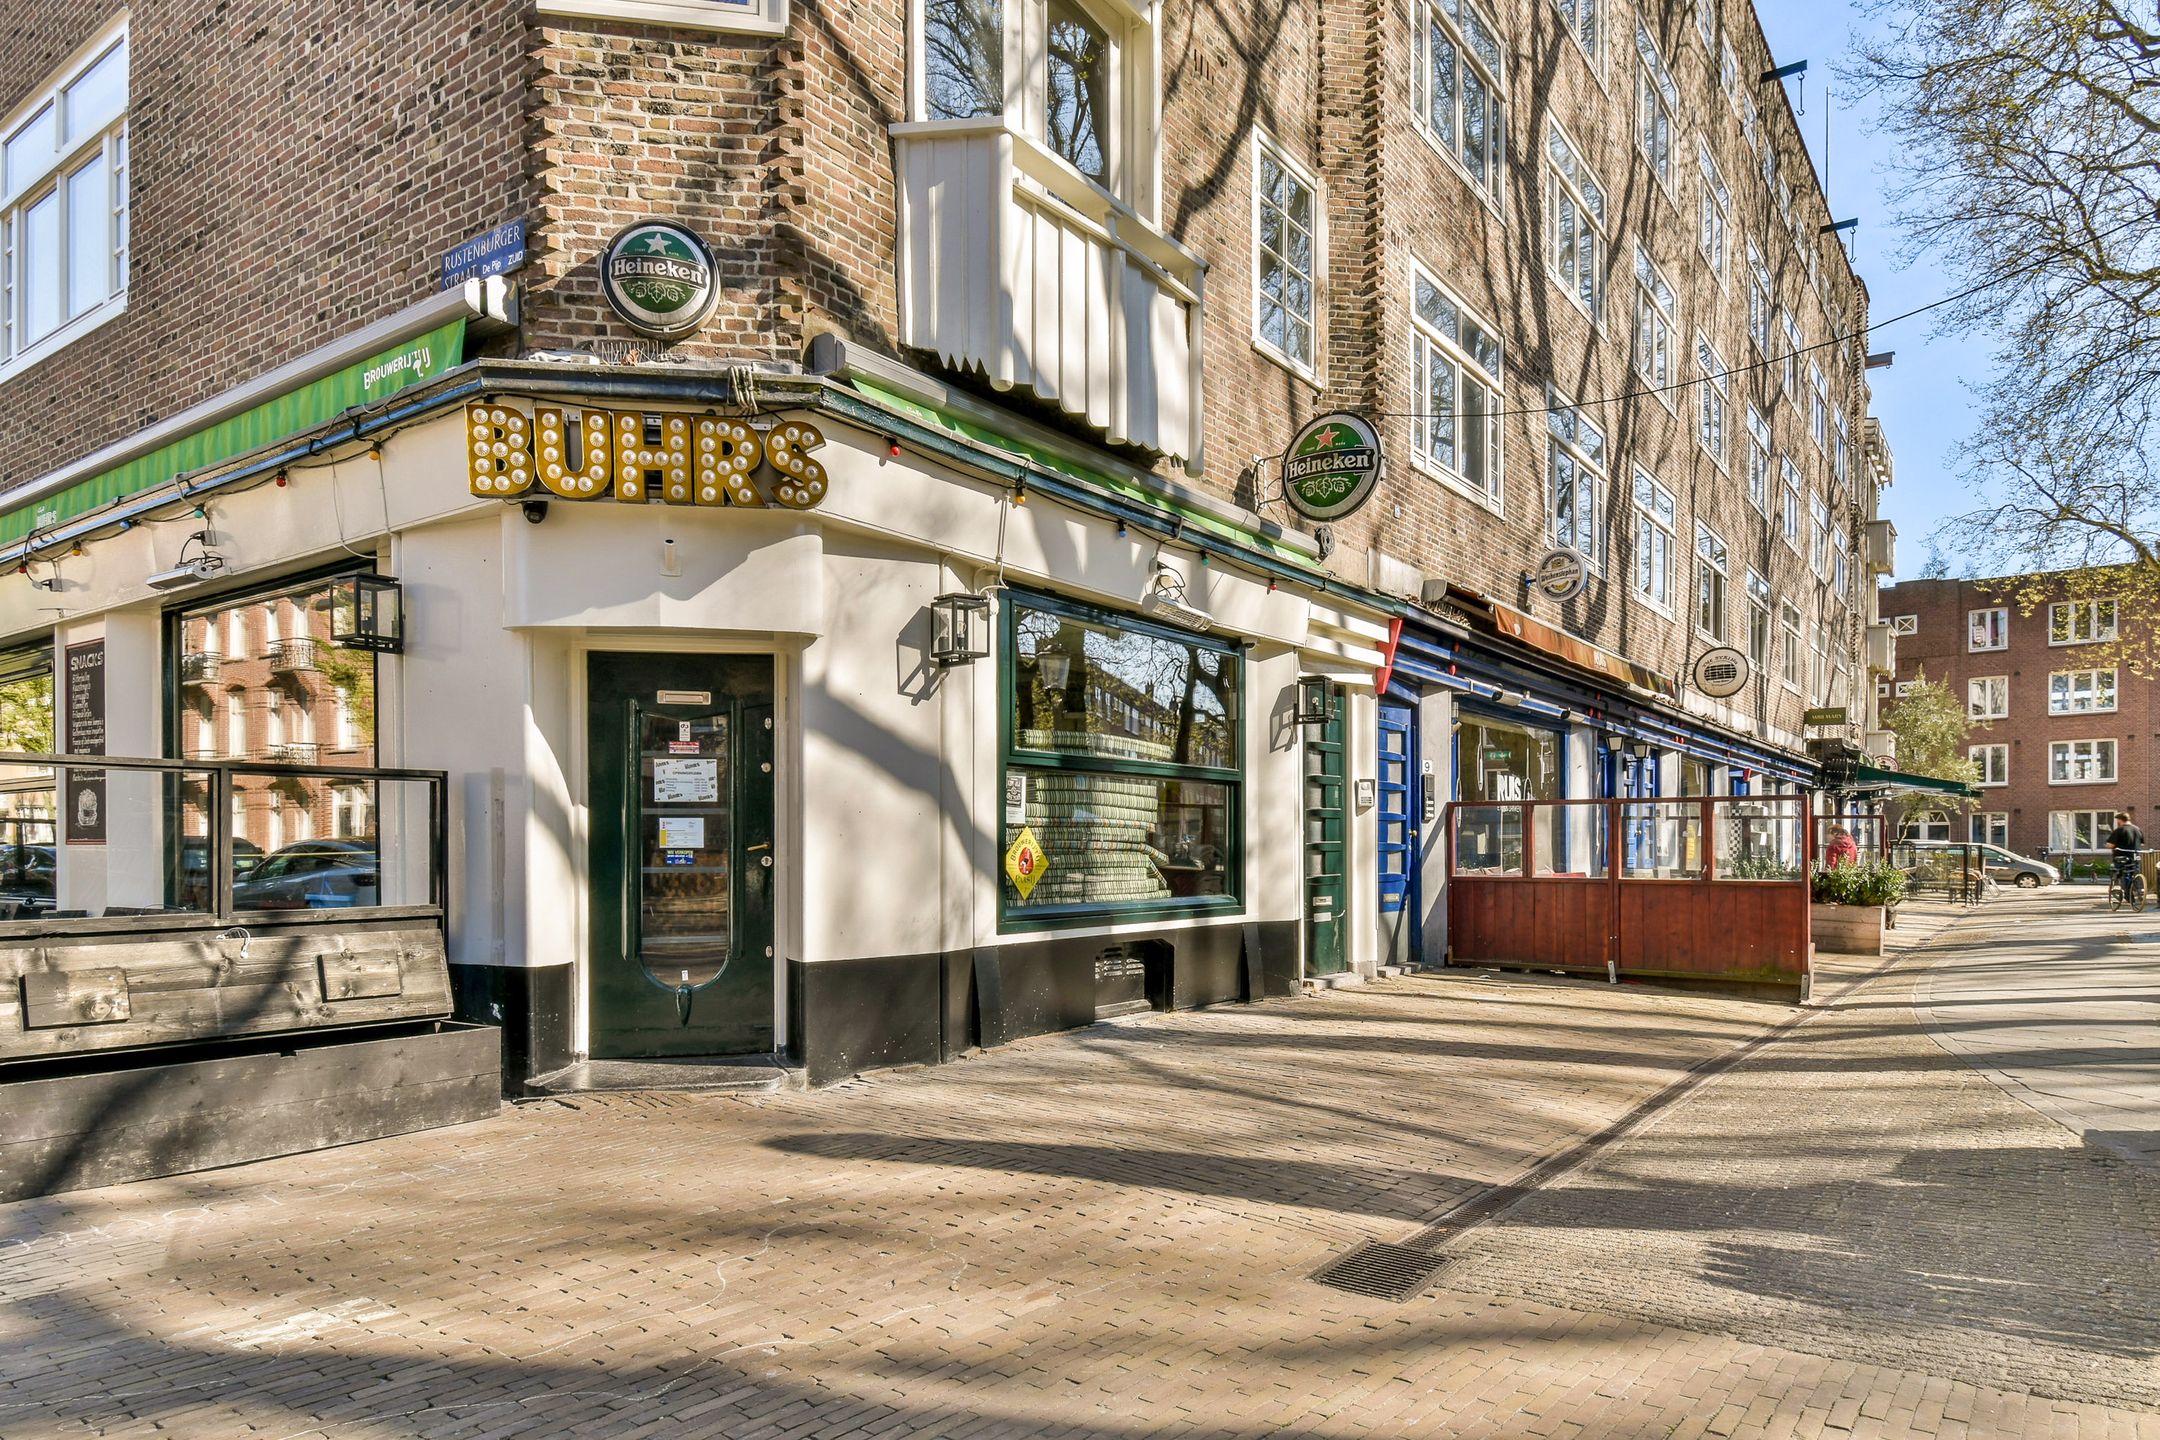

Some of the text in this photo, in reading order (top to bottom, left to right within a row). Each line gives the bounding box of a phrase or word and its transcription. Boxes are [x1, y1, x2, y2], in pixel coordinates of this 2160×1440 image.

[445, 225, 520, 272] RUSTENBURGER
[507, 250, 523, 266] ZUID
[444, 264, 477, 290] STRAAT
[614, 258, 703, 284] Heineken
[363, 352, 412, 390] BROUWERIJ
[464, 403, 829, 509] BUHRS
[1288, 452, 1370, 479] Heineken
[71, 651, 104, 671] SNACKS
[1424, 761, 1431, 772] 9
